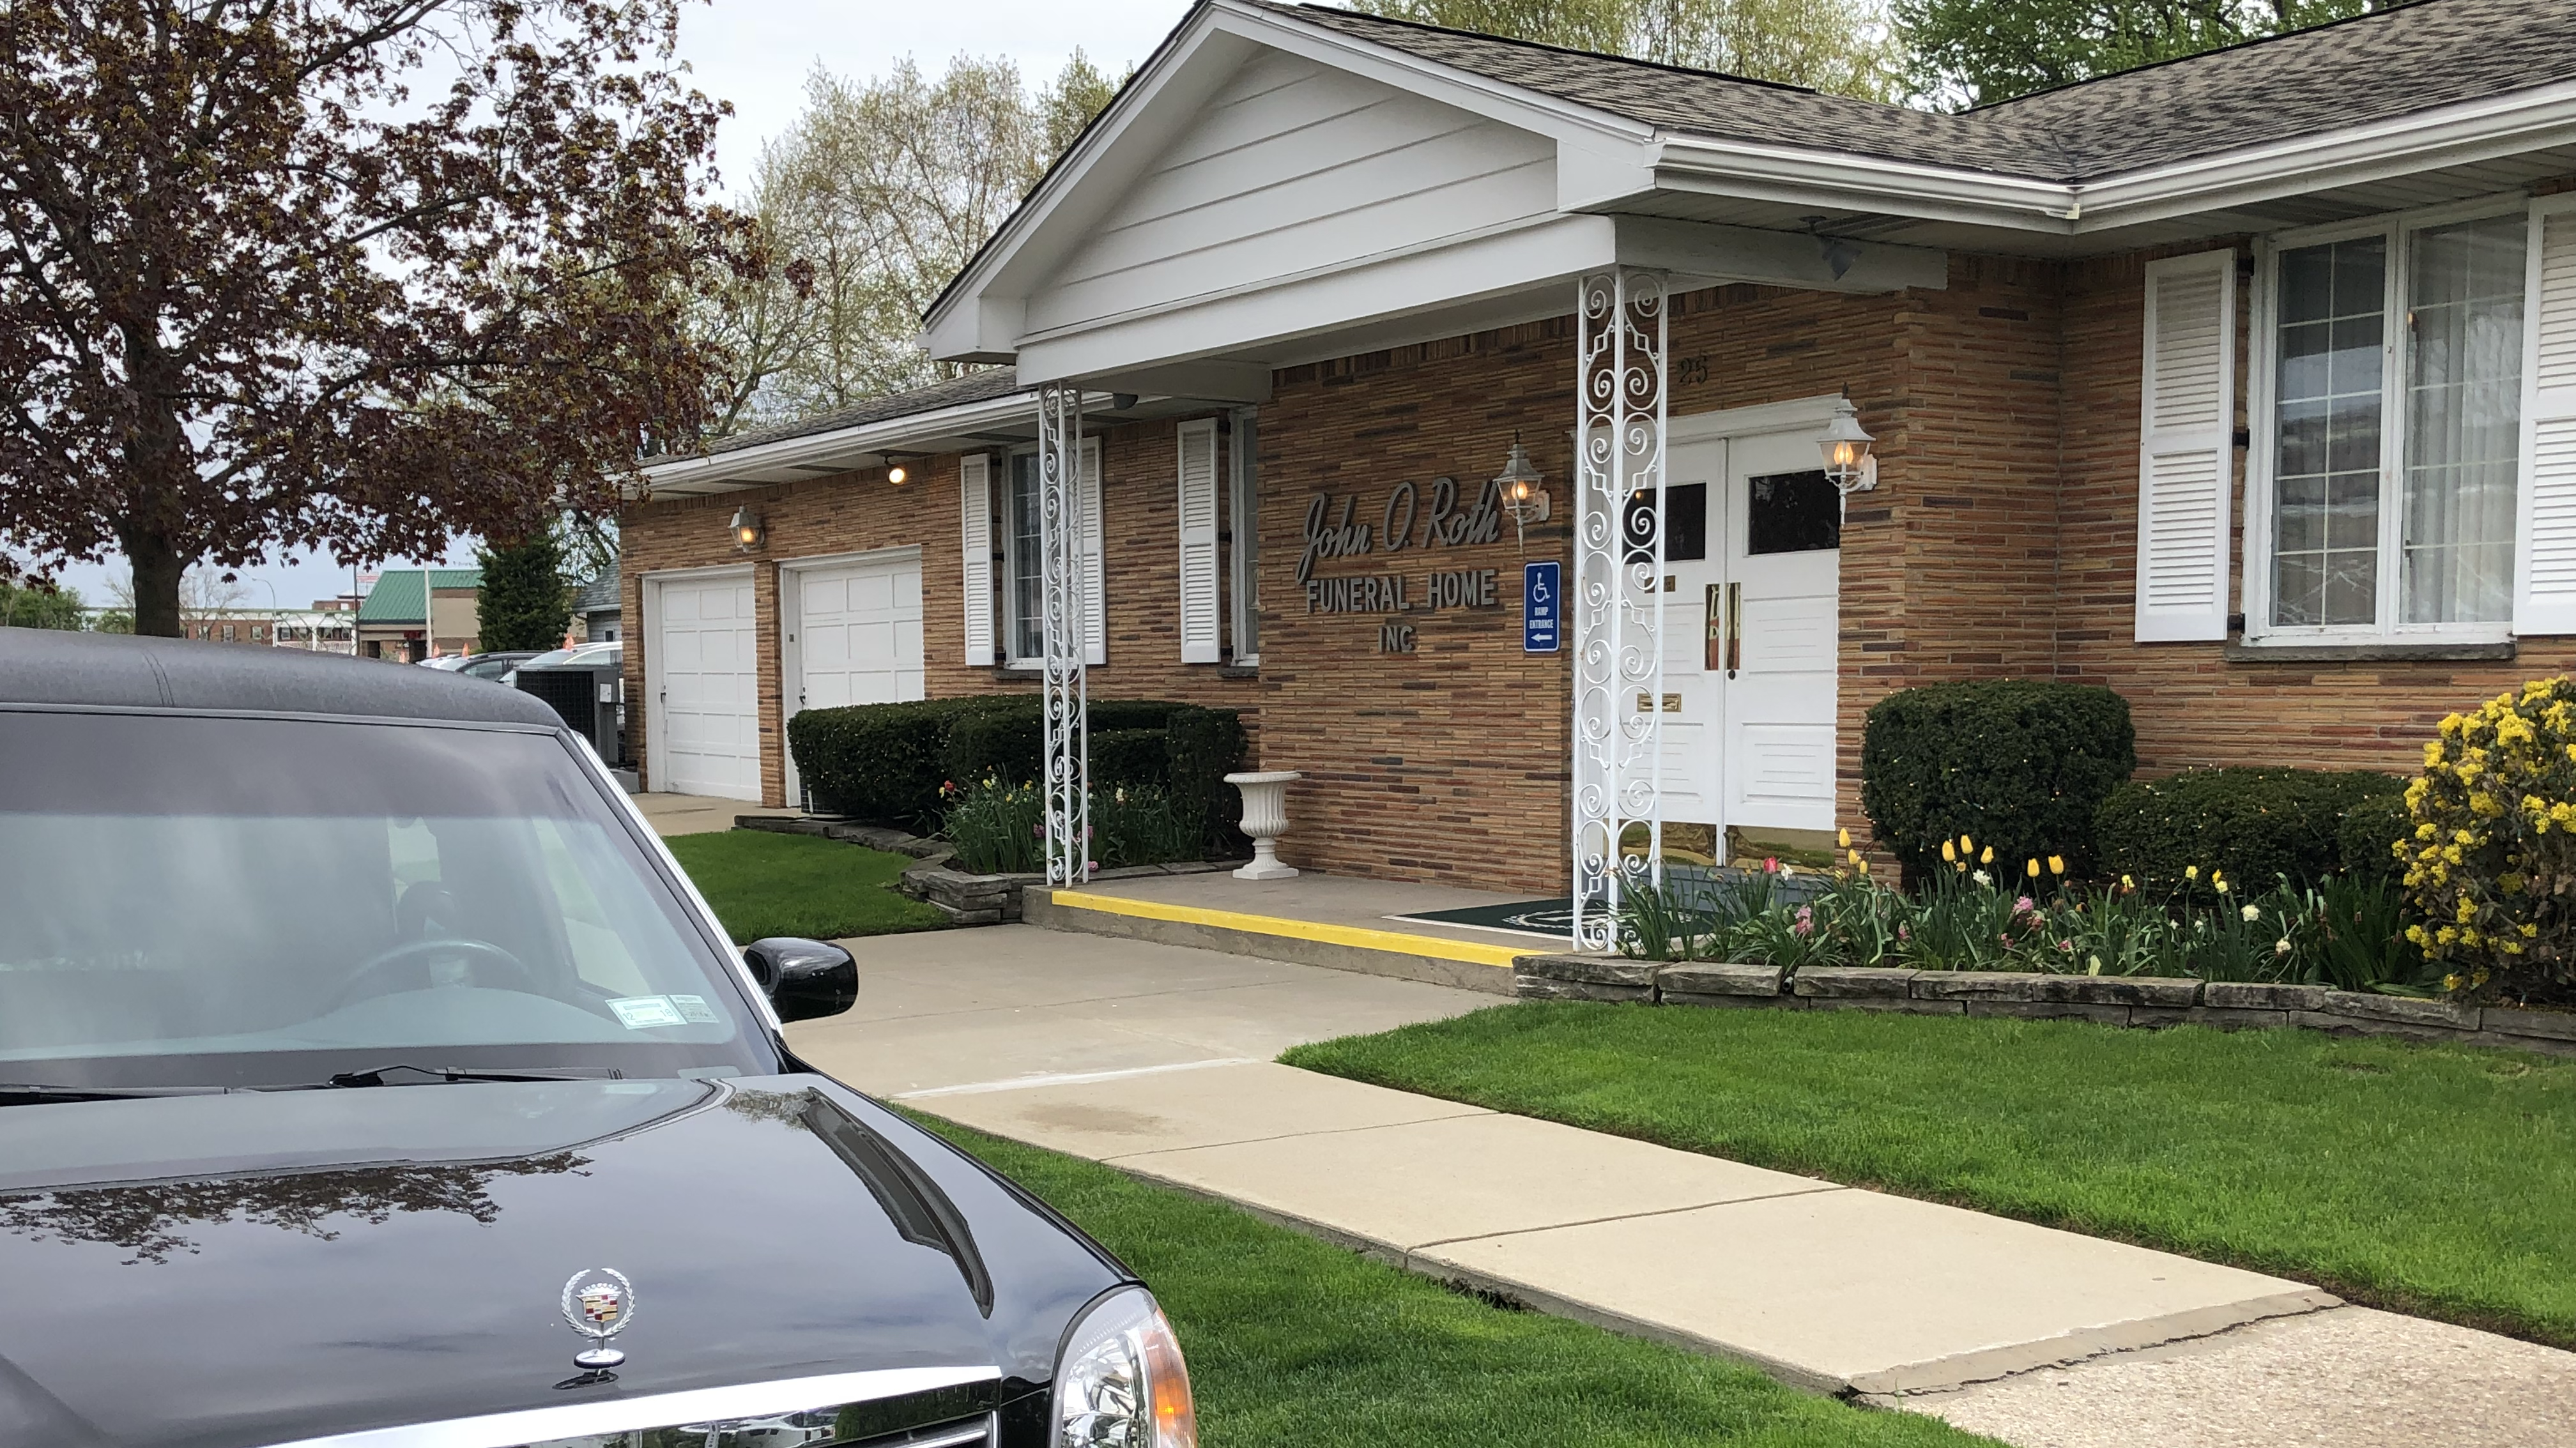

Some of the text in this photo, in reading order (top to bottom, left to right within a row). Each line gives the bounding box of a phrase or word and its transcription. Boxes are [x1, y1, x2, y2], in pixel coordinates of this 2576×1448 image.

[1676, 356, 1708, 385] 25
[1297, 477, 1499, 585] John O. Roth
[1306, 569, 1496, 613] FUNERAL HOME
[1529, 619, 1554, 629] ENTRANCE
[1535, 607, 1549, 616] RAMP
[1378, 625, 1414, 653] INC
[622, 1012, 636, 1021] 12
[659, 1009, 674, 1017] 18
